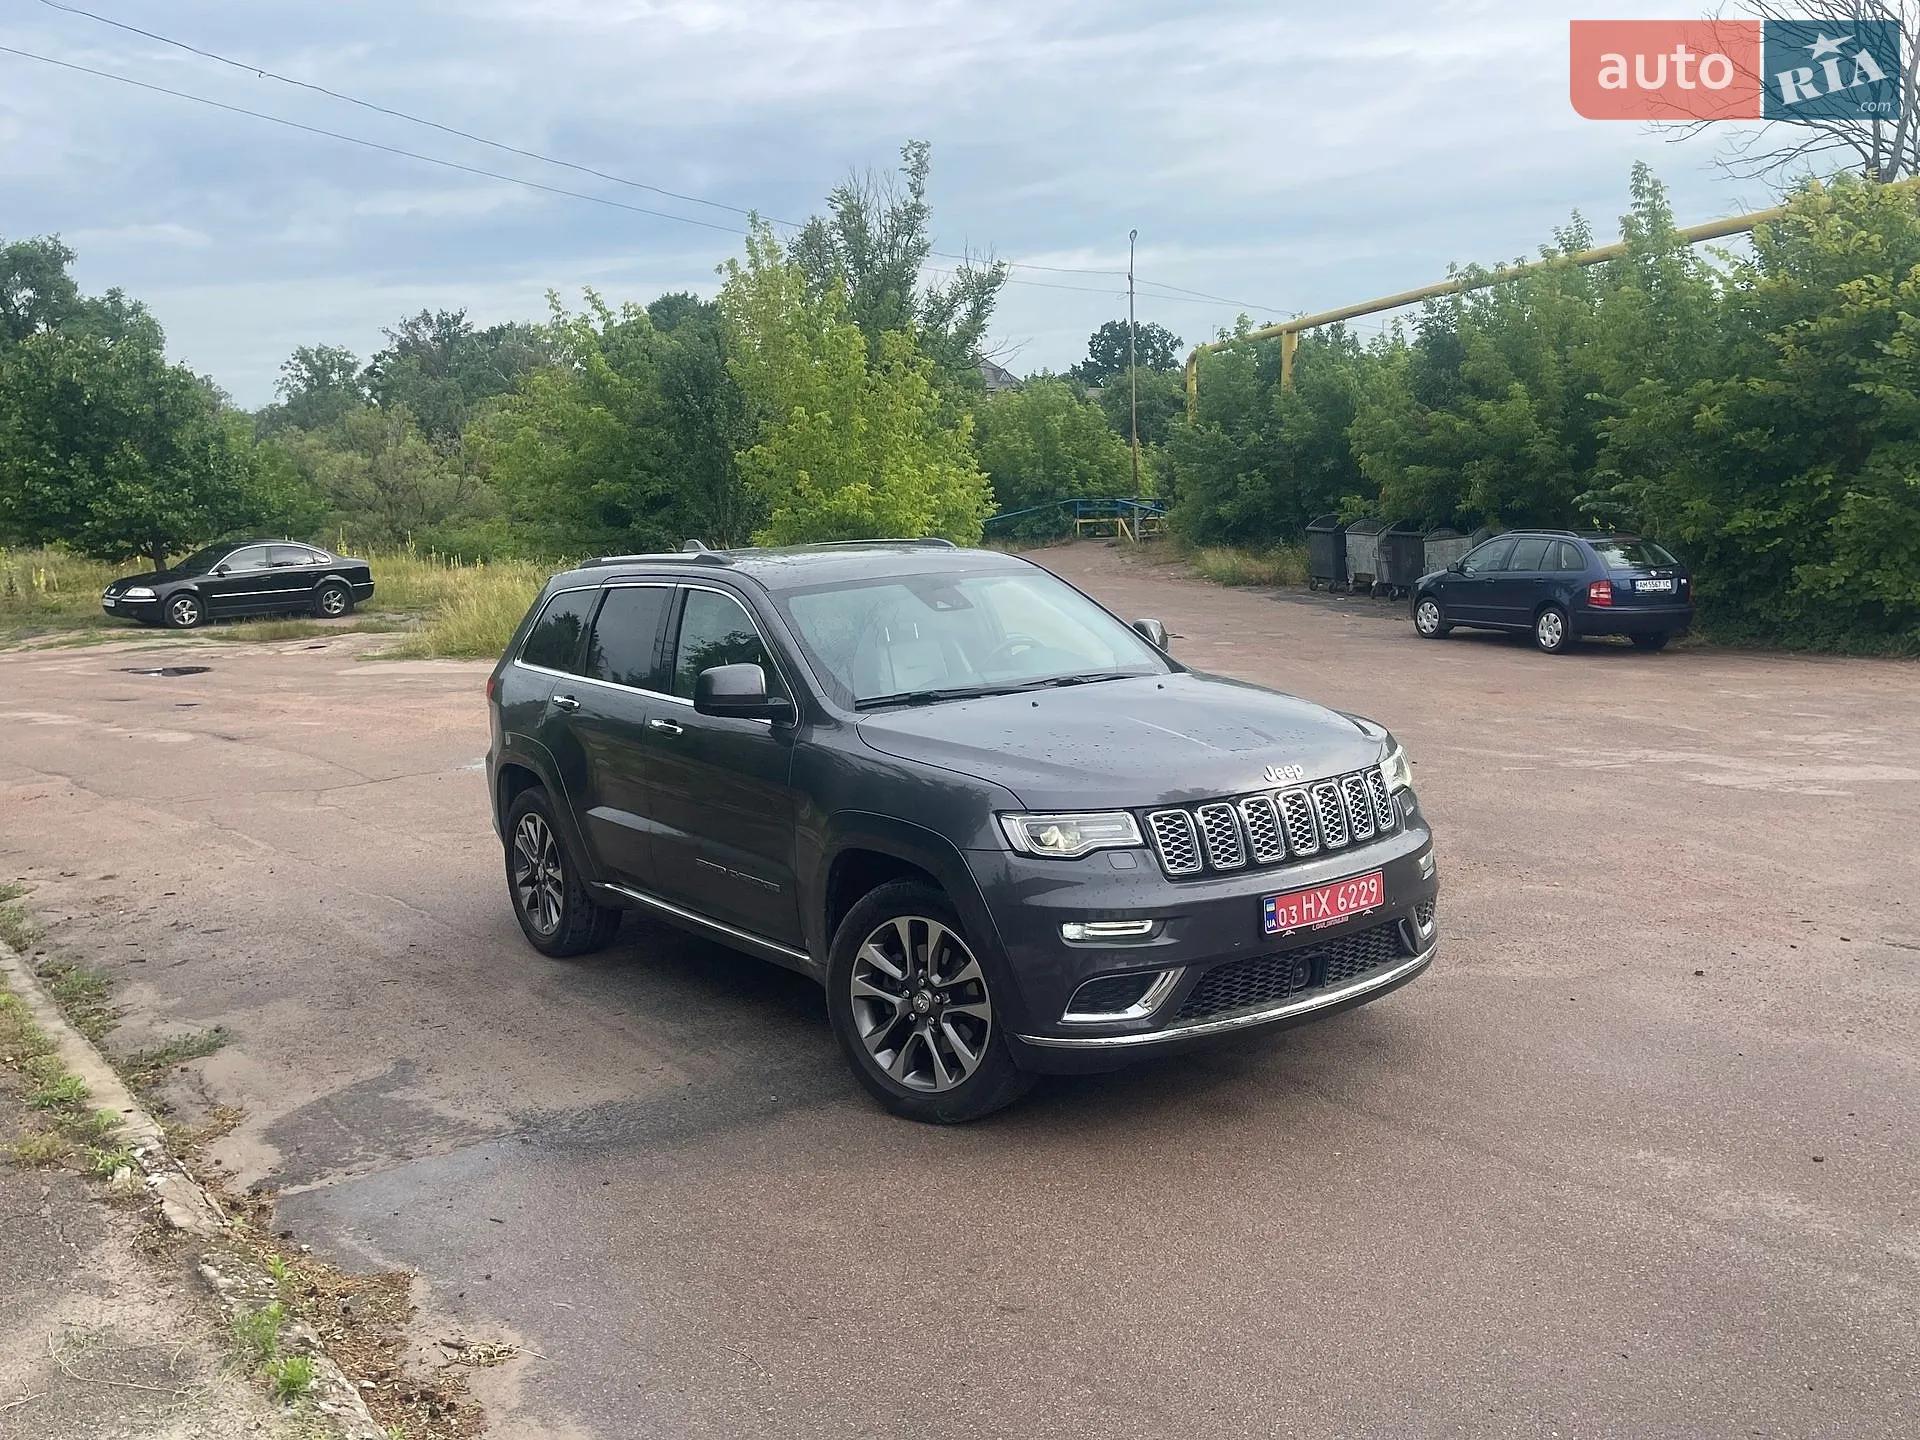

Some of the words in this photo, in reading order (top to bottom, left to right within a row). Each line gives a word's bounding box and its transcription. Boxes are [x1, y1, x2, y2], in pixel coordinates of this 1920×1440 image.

[1264, 763, 1304, 782] Jeep
[1278, 905, 1298, 926] 03
[1302, 889, 1331, 920] HX
[1337, 878, 1377, 911] 6229
[1266, 919, 1276, 928] UA
